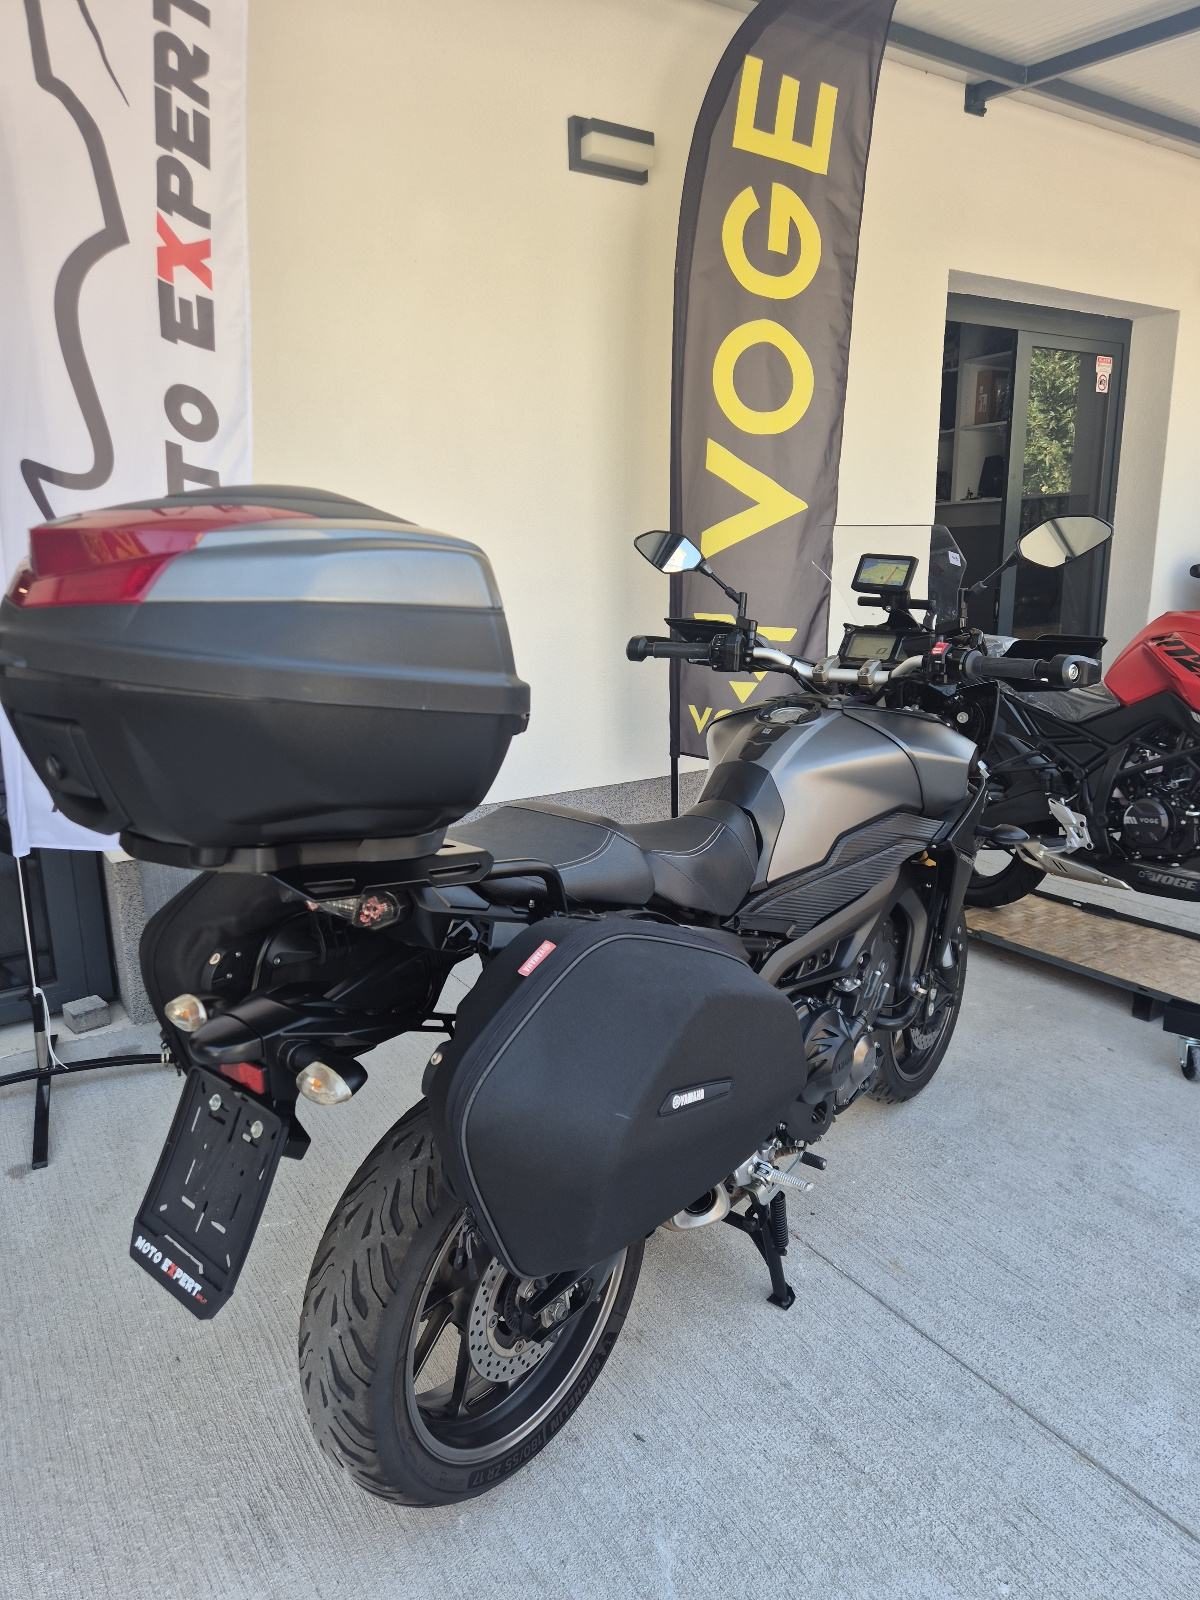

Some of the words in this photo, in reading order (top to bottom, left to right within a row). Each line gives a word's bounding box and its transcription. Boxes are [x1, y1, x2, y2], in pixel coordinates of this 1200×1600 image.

[153, 0, 216, 352] EXPERT
[701, 55, 839, 558] VOGE
[164, 383, 220, 499] TO
[1150, 872, 1197, 891] VOGE
[680, 1088, 705, 1107] YAMAHA
[134, 1235, 162, 1264] MOTO
[161, 1258, 202, 1297] EXPERT
[550, 1358, 601, 1432] MICHELIN
[487, 1466, 501, 1480] ZR
[505, 1434, 544, 1469] 180/55
[472, 1469, 484, 1486] 17
